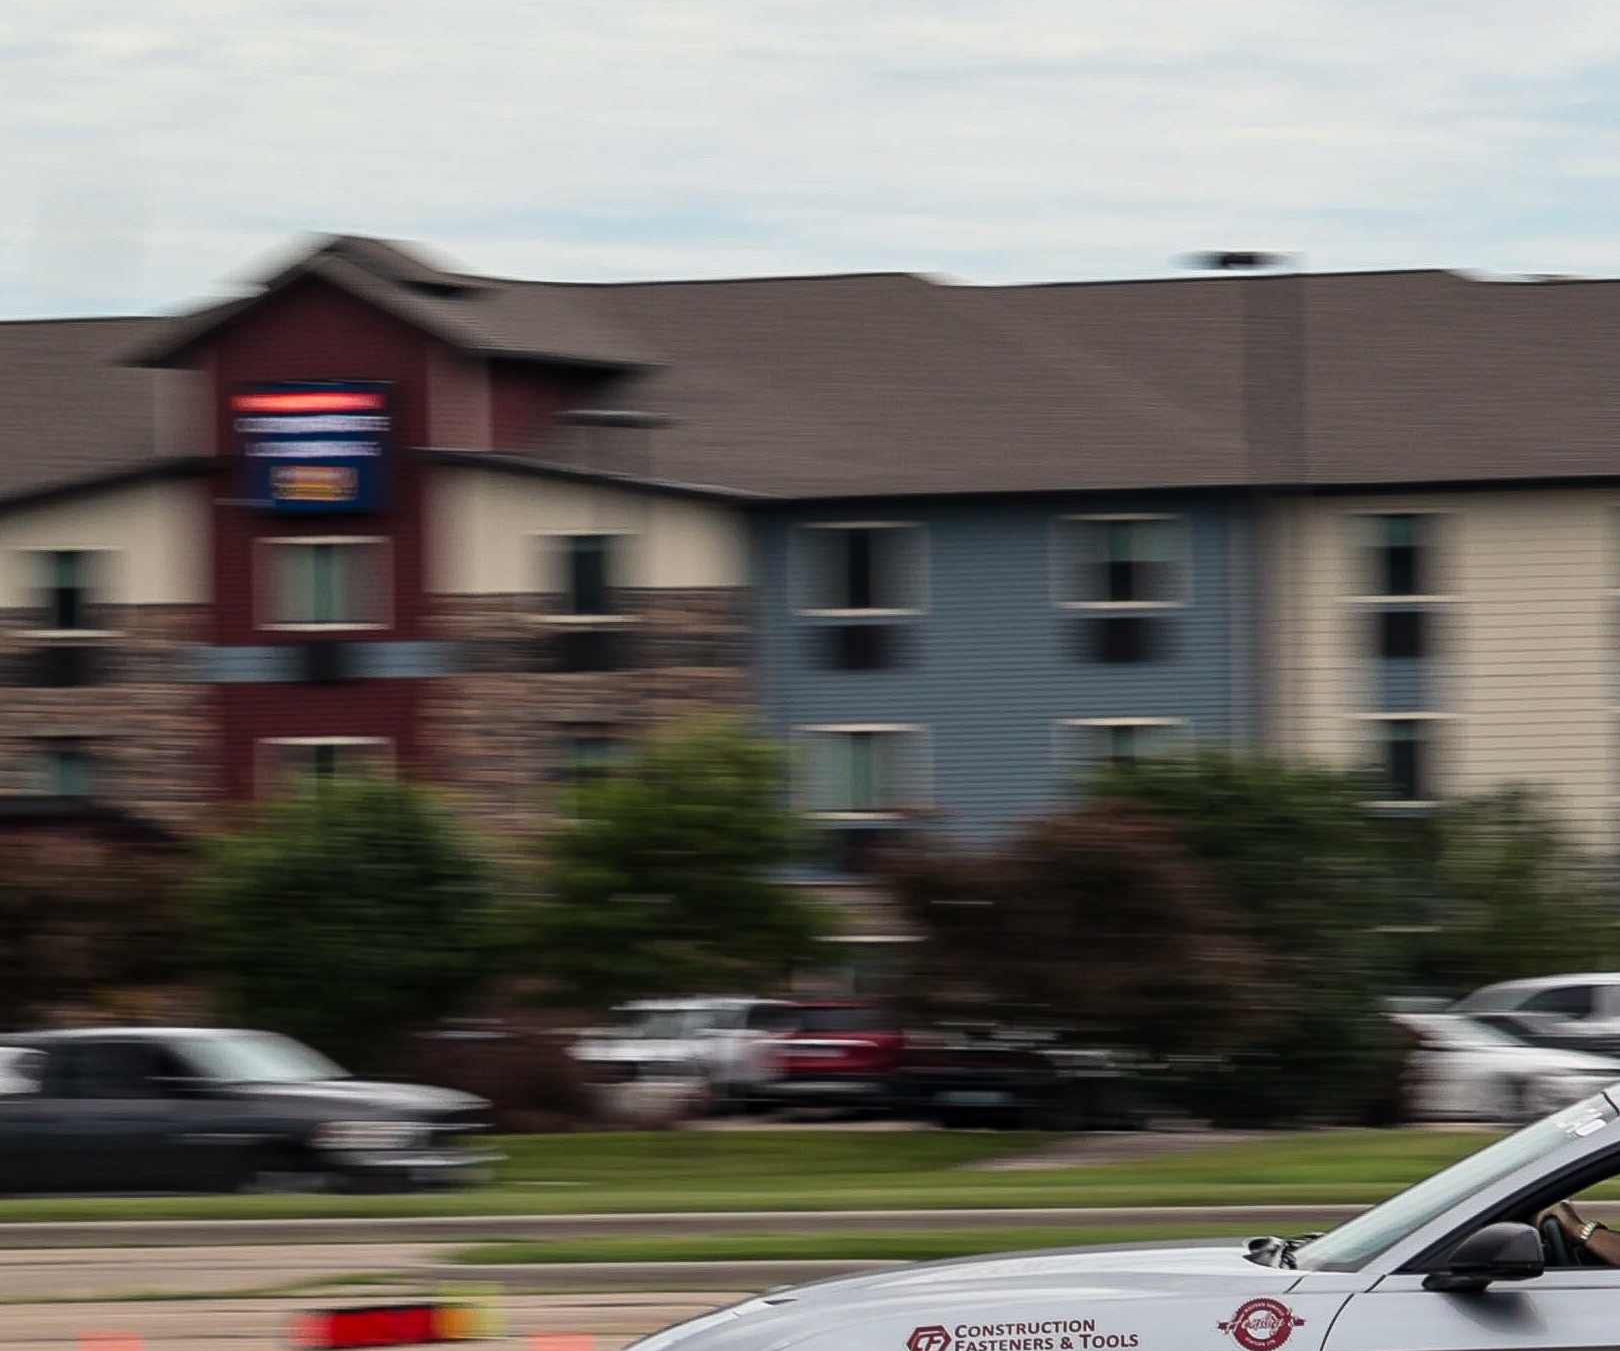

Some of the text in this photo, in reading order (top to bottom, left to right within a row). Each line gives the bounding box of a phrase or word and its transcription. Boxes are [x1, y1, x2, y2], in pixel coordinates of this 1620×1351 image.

[954, 1318, 1096, 1339] CONSTRUCTION
[1059, 1336, 1074, 1350] &
[1079, 1333, 1139, 1349] TOOLS
